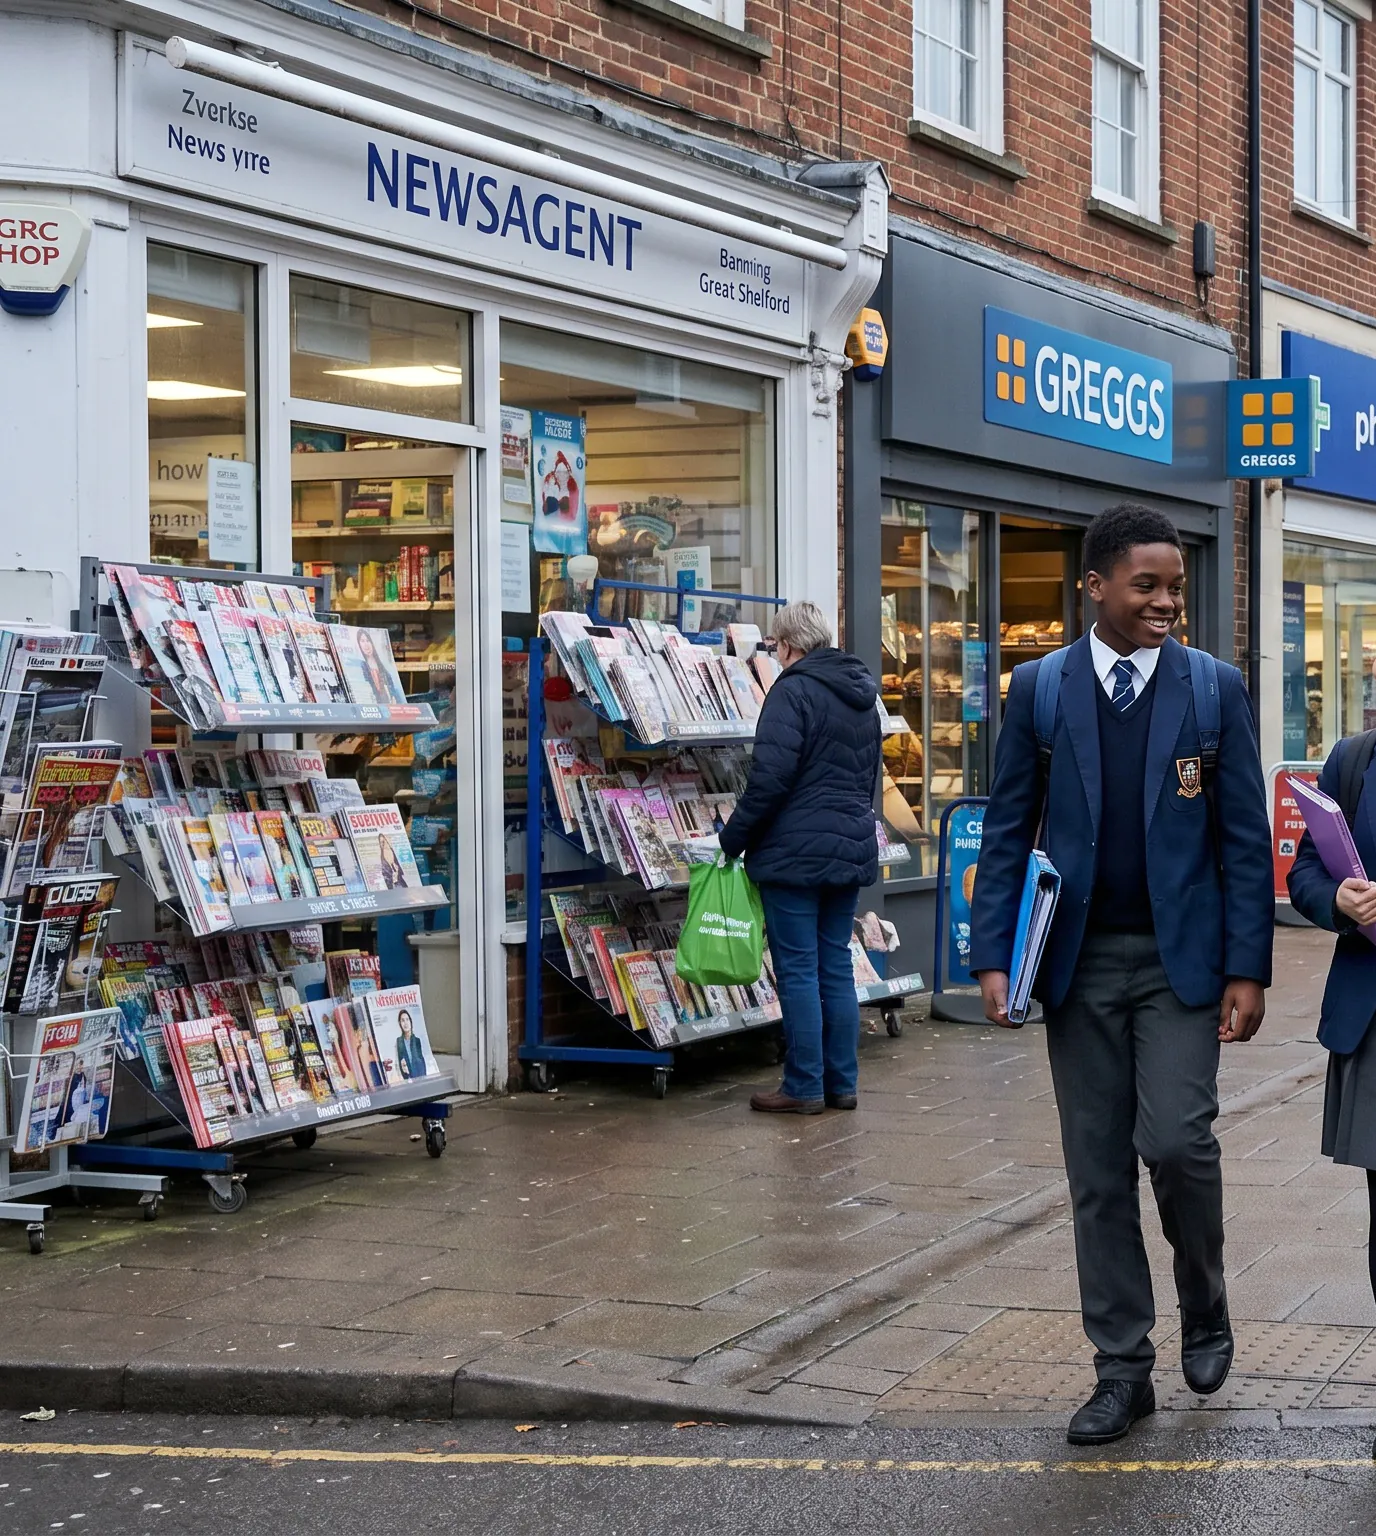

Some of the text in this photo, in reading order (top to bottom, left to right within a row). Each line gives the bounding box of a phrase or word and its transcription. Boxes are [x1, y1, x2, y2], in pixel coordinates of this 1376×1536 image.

[181, 88, 258, 133] Zverkse
[168, 124, 226, 163] News
[367, 141, 642, 272] NEWSAGENT
[699, 272, 790, 314] Great Shelford
[1034, 345, 1165, 440] GREGGS
[157, 459, 204, 481] how
[1240, 454, 1296, 467] GREGGS
